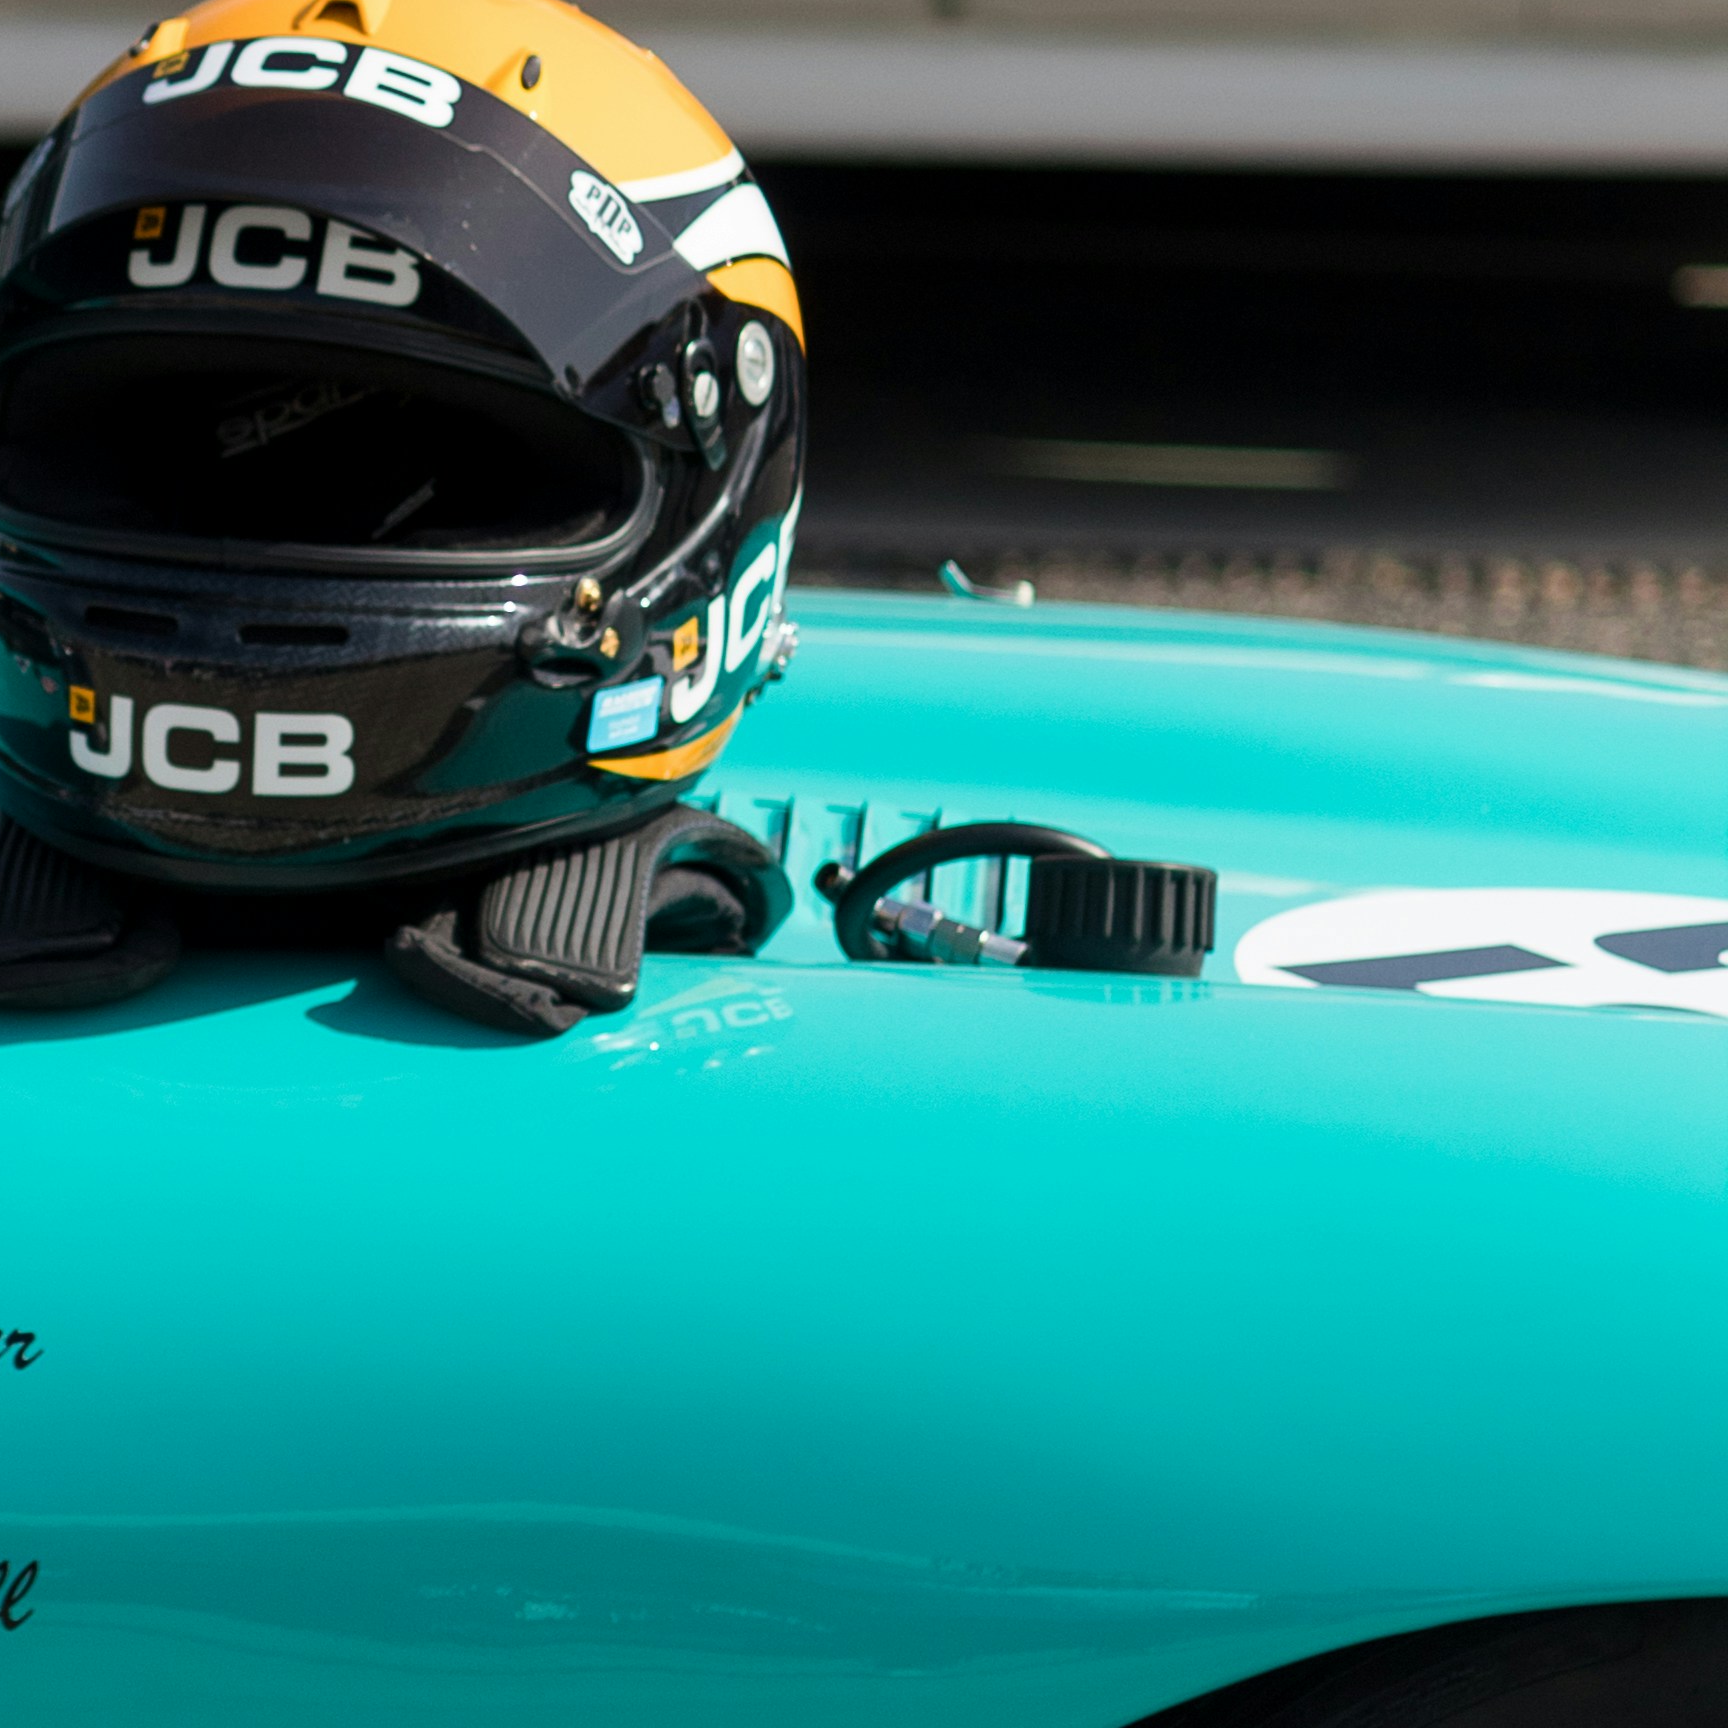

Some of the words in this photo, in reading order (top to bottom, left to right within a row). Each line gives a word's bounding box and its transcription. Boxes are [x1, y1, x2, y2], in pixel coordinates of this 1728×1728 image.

[142, 36, 462, 128] JCB
[128, 204, 423, 308] JCB
[69, 693, 356, 798] JCB
